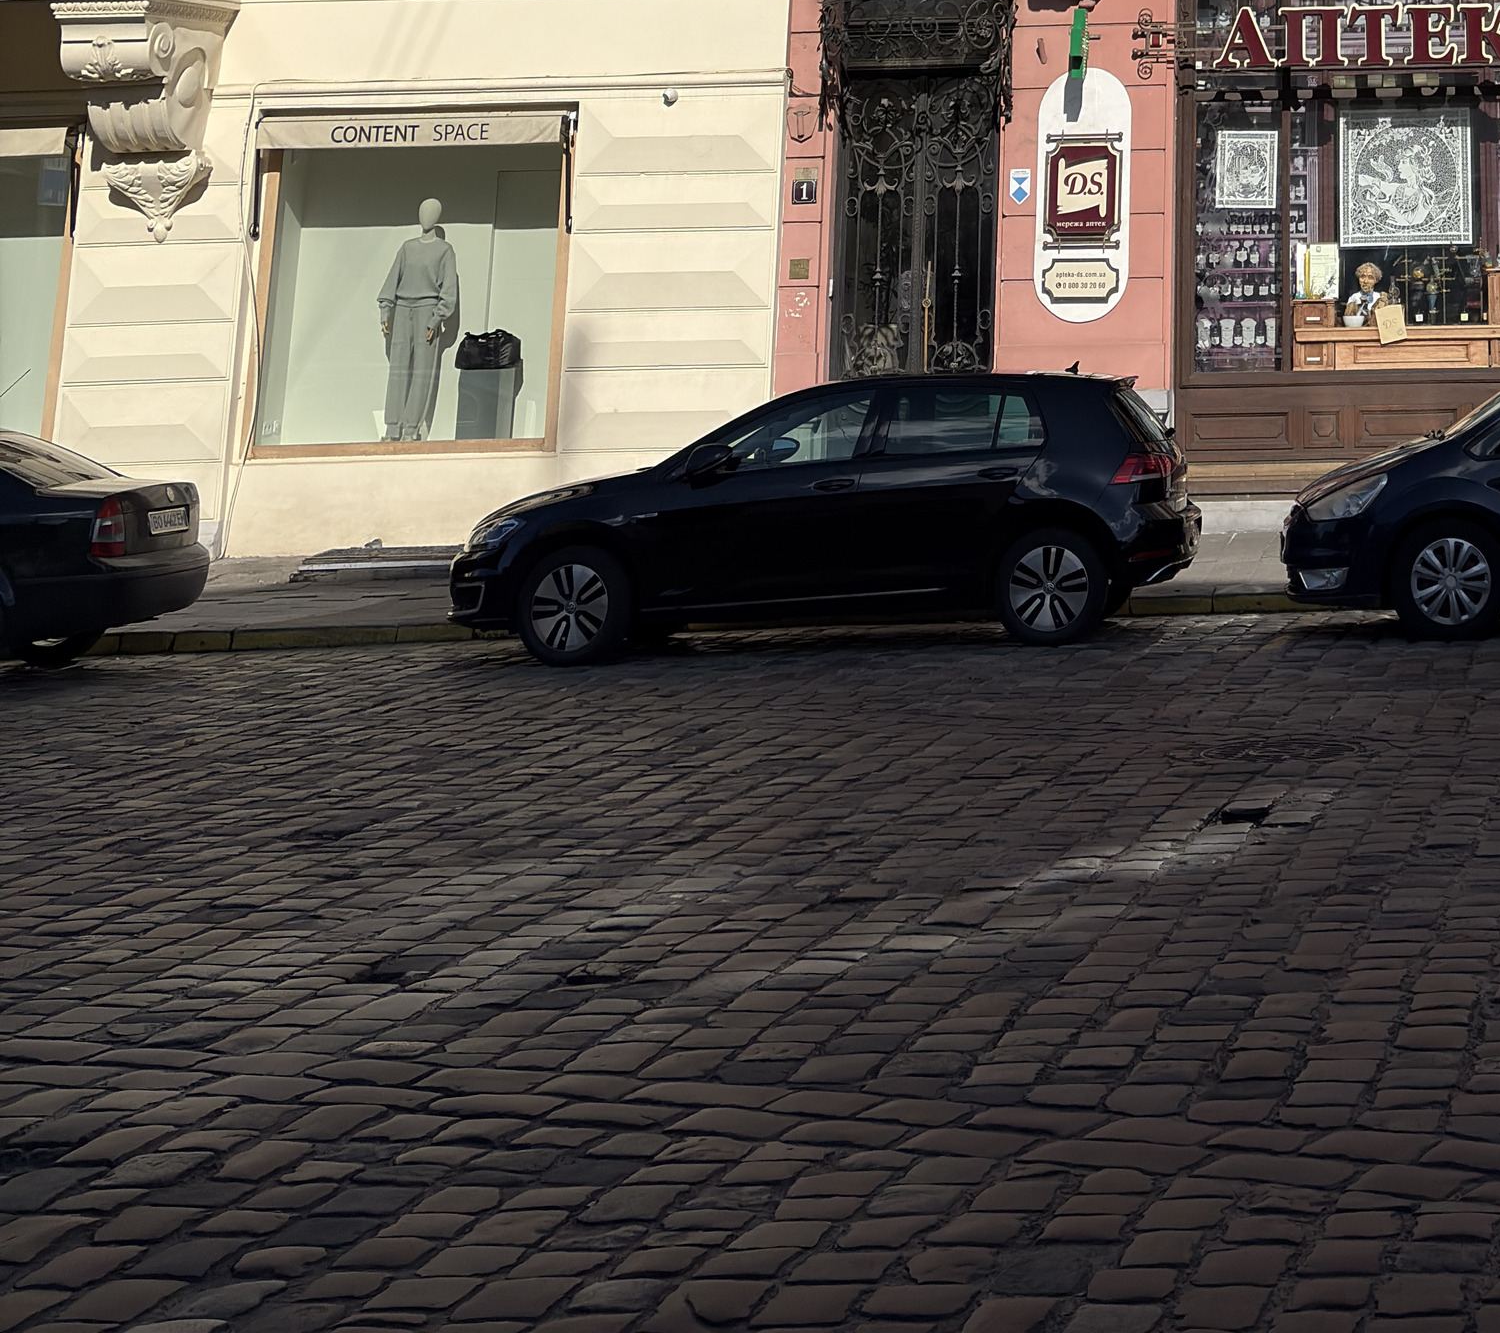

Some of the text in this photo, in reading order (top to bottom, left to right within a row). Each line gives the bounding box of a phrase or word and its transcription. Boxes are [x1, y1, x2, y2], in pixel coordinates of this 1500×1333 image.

[331, 123, 490, 144] CONTENT SPACE
[800, 182, 808, 200] 1
[1064, 172, 1104, 195] D.S.
